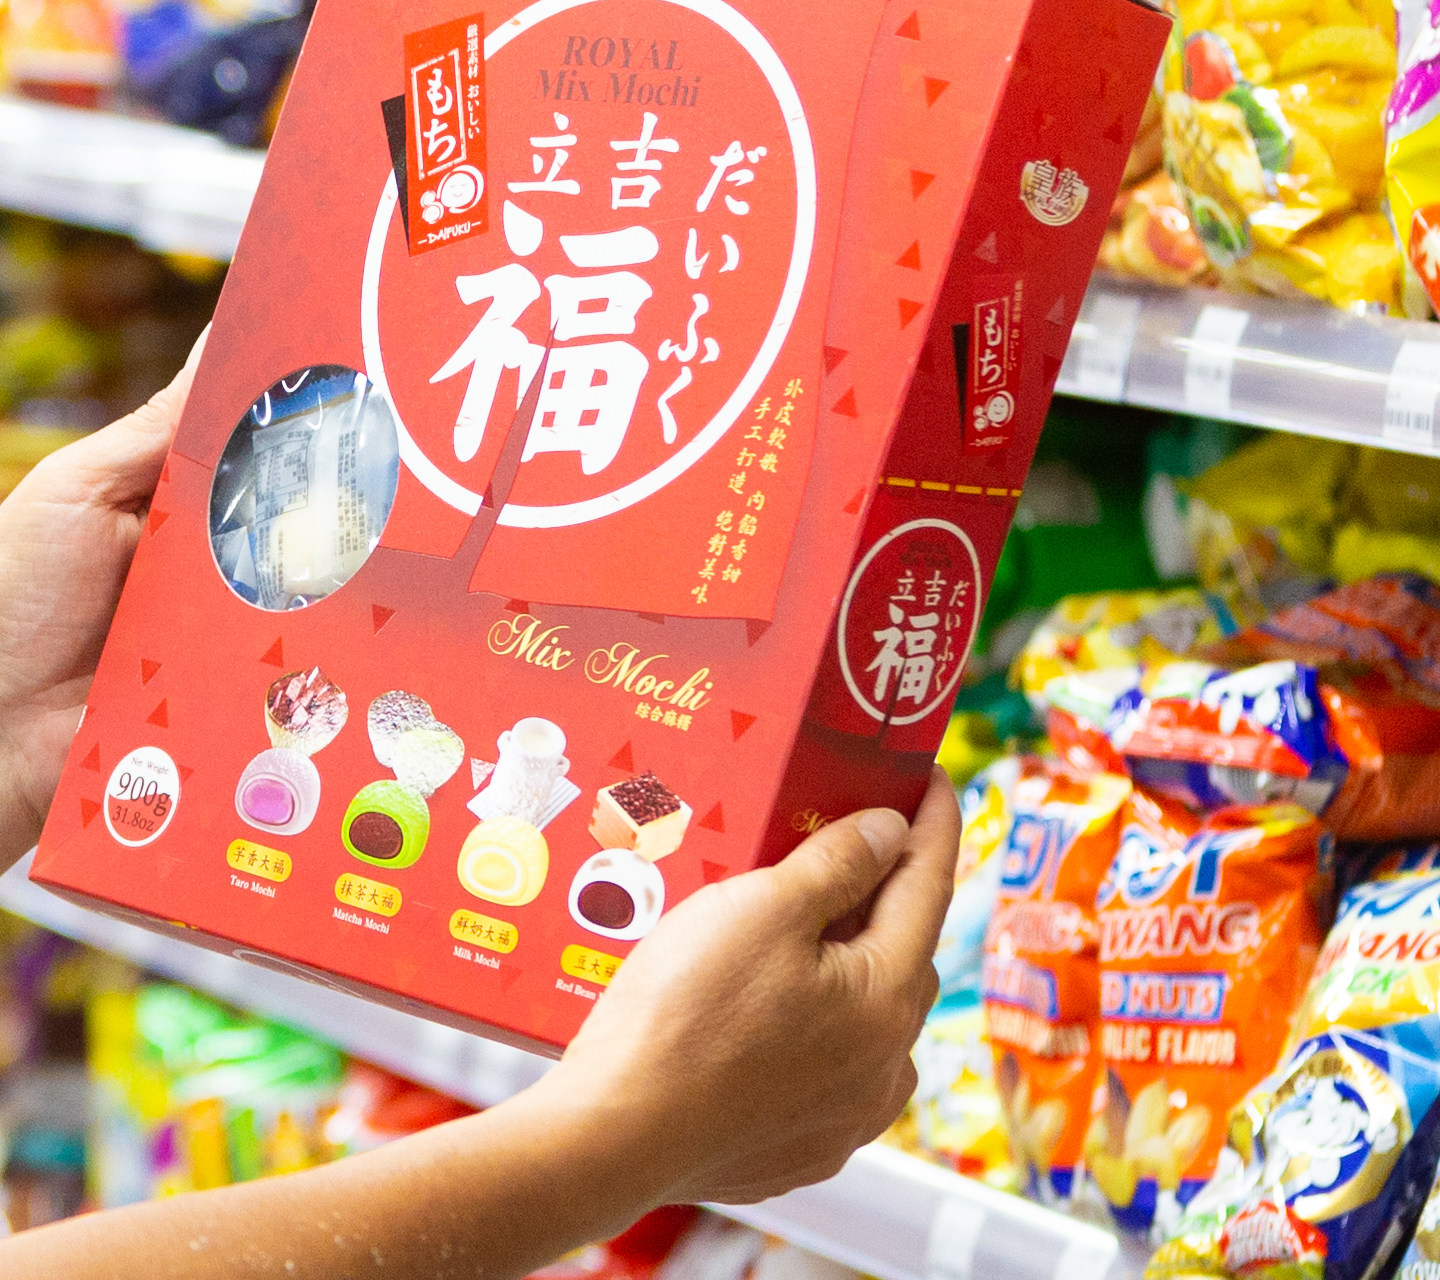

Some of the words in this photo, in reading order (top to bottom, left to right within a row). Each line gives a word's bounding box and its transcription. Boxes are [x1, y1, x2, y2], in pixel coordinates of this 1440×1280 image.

[562, 35, 684, 71] ROYAL
[533, 69, 594, 101] Mix
[603, 73, 702, 107] Mochi
[423, 68, 457, 163] もち
[1031, 158, 1080, 206] 皇族
[427, 222, 471, 243] DAIFUKU
[657, 140, 768, 445] だいふく
[428, 199, 660, 475] 福
[979, 308, 1003, 384] もち
[726, 397, 772, 495] 手工打造
[865, 602, 941, 706] 福
[934, 579, 970, 692] だいふく
[487, 613, 576, 671] Mix
[584, 642, 714, 712] Mochi
[115, 772, 172, 818] 900g
[112, 805, 156, 833] 31.8oz
[232, 844, 286, 877] 芋香大福
[230, 874, 250, 890] Taro
[250, 881, 277, 899] Mochi
[339, 878, 395, 910] 抹茶大福
[332, 907, 364, 927] Matcha
[364, 917, 391, 935] Mochi
[454, 915, 511, 947] 鮮奶大福
[452, 945, 473, 962] Milk
[473, 951, 501, 970] Mochi
[554, 978, 573, 993] Red
[574, 983, 597, 1001] Bean
